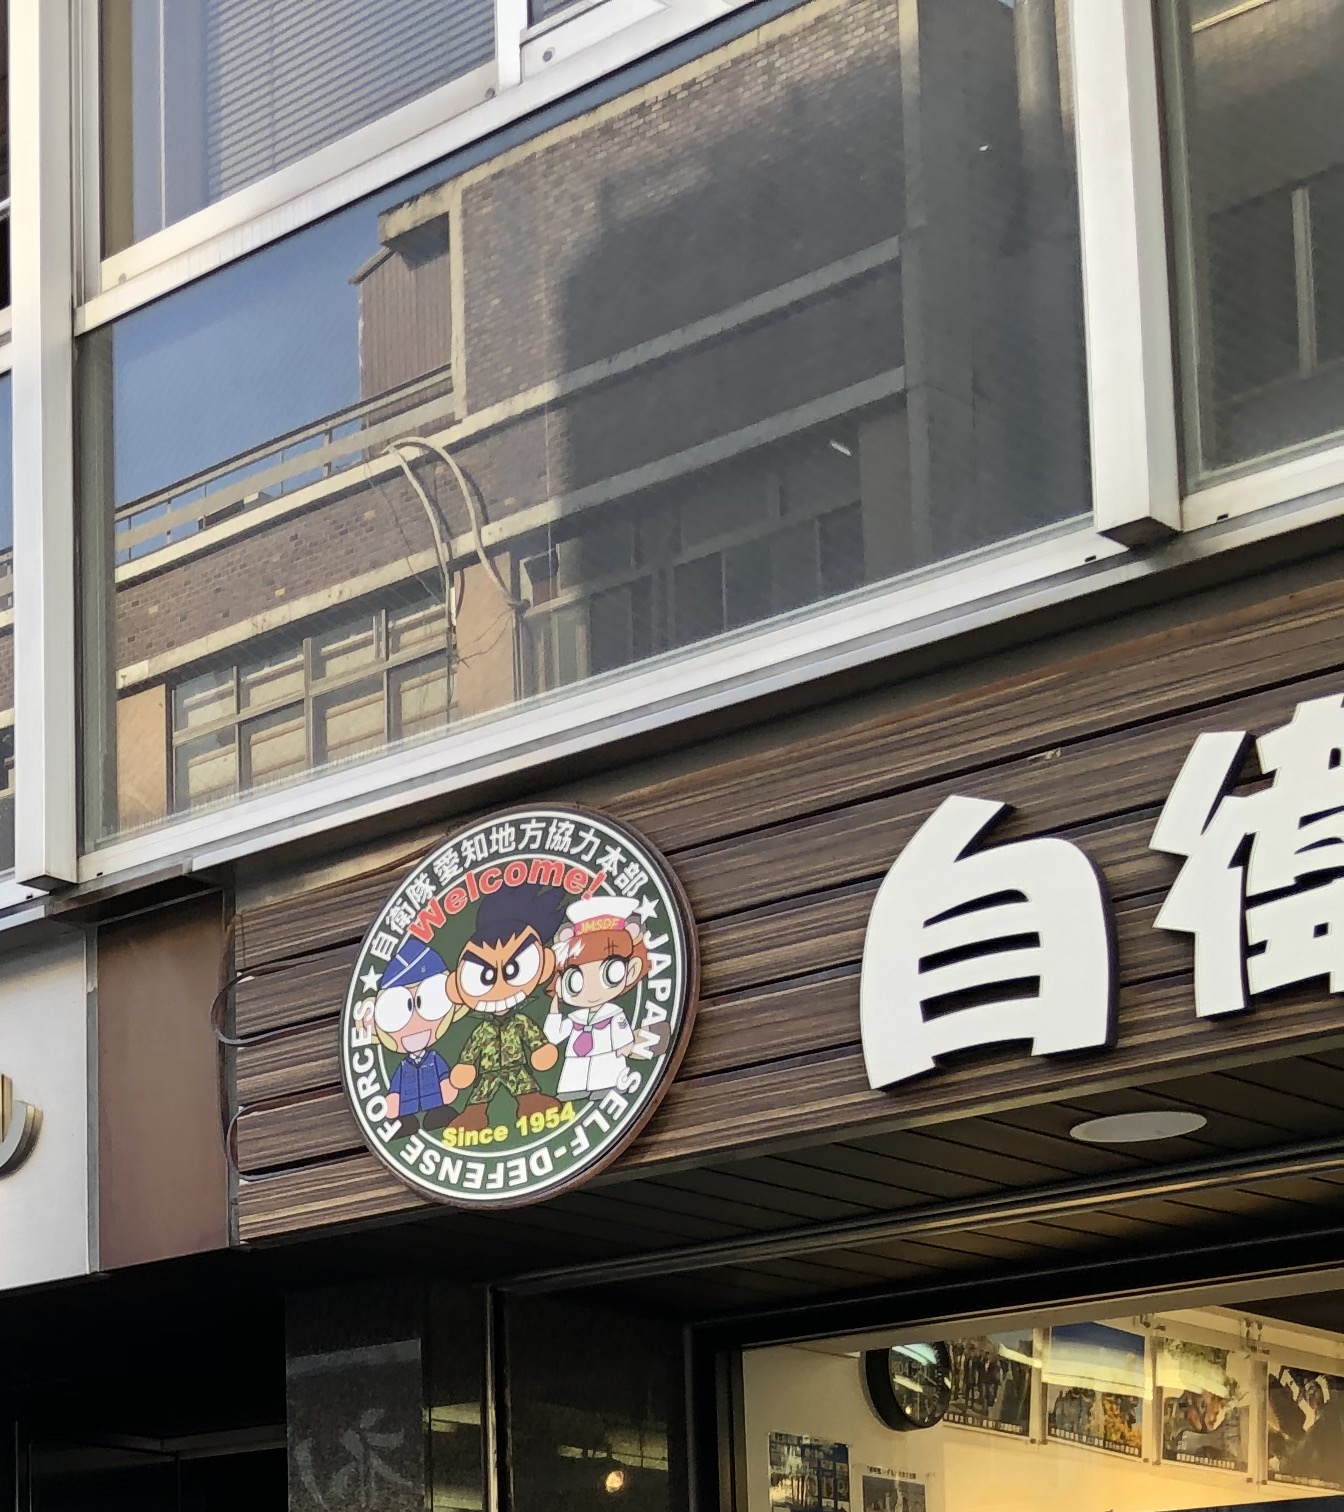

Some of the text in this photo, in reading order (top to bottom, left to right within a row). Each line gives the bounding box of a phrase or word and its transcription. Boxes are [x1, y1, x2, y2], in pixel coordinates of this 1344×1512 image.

[406, 857, 607, 944] Welcome!
[351, 997, 403, 1145] FORCES
[442, 1103, 577, 1149] Since 1954
